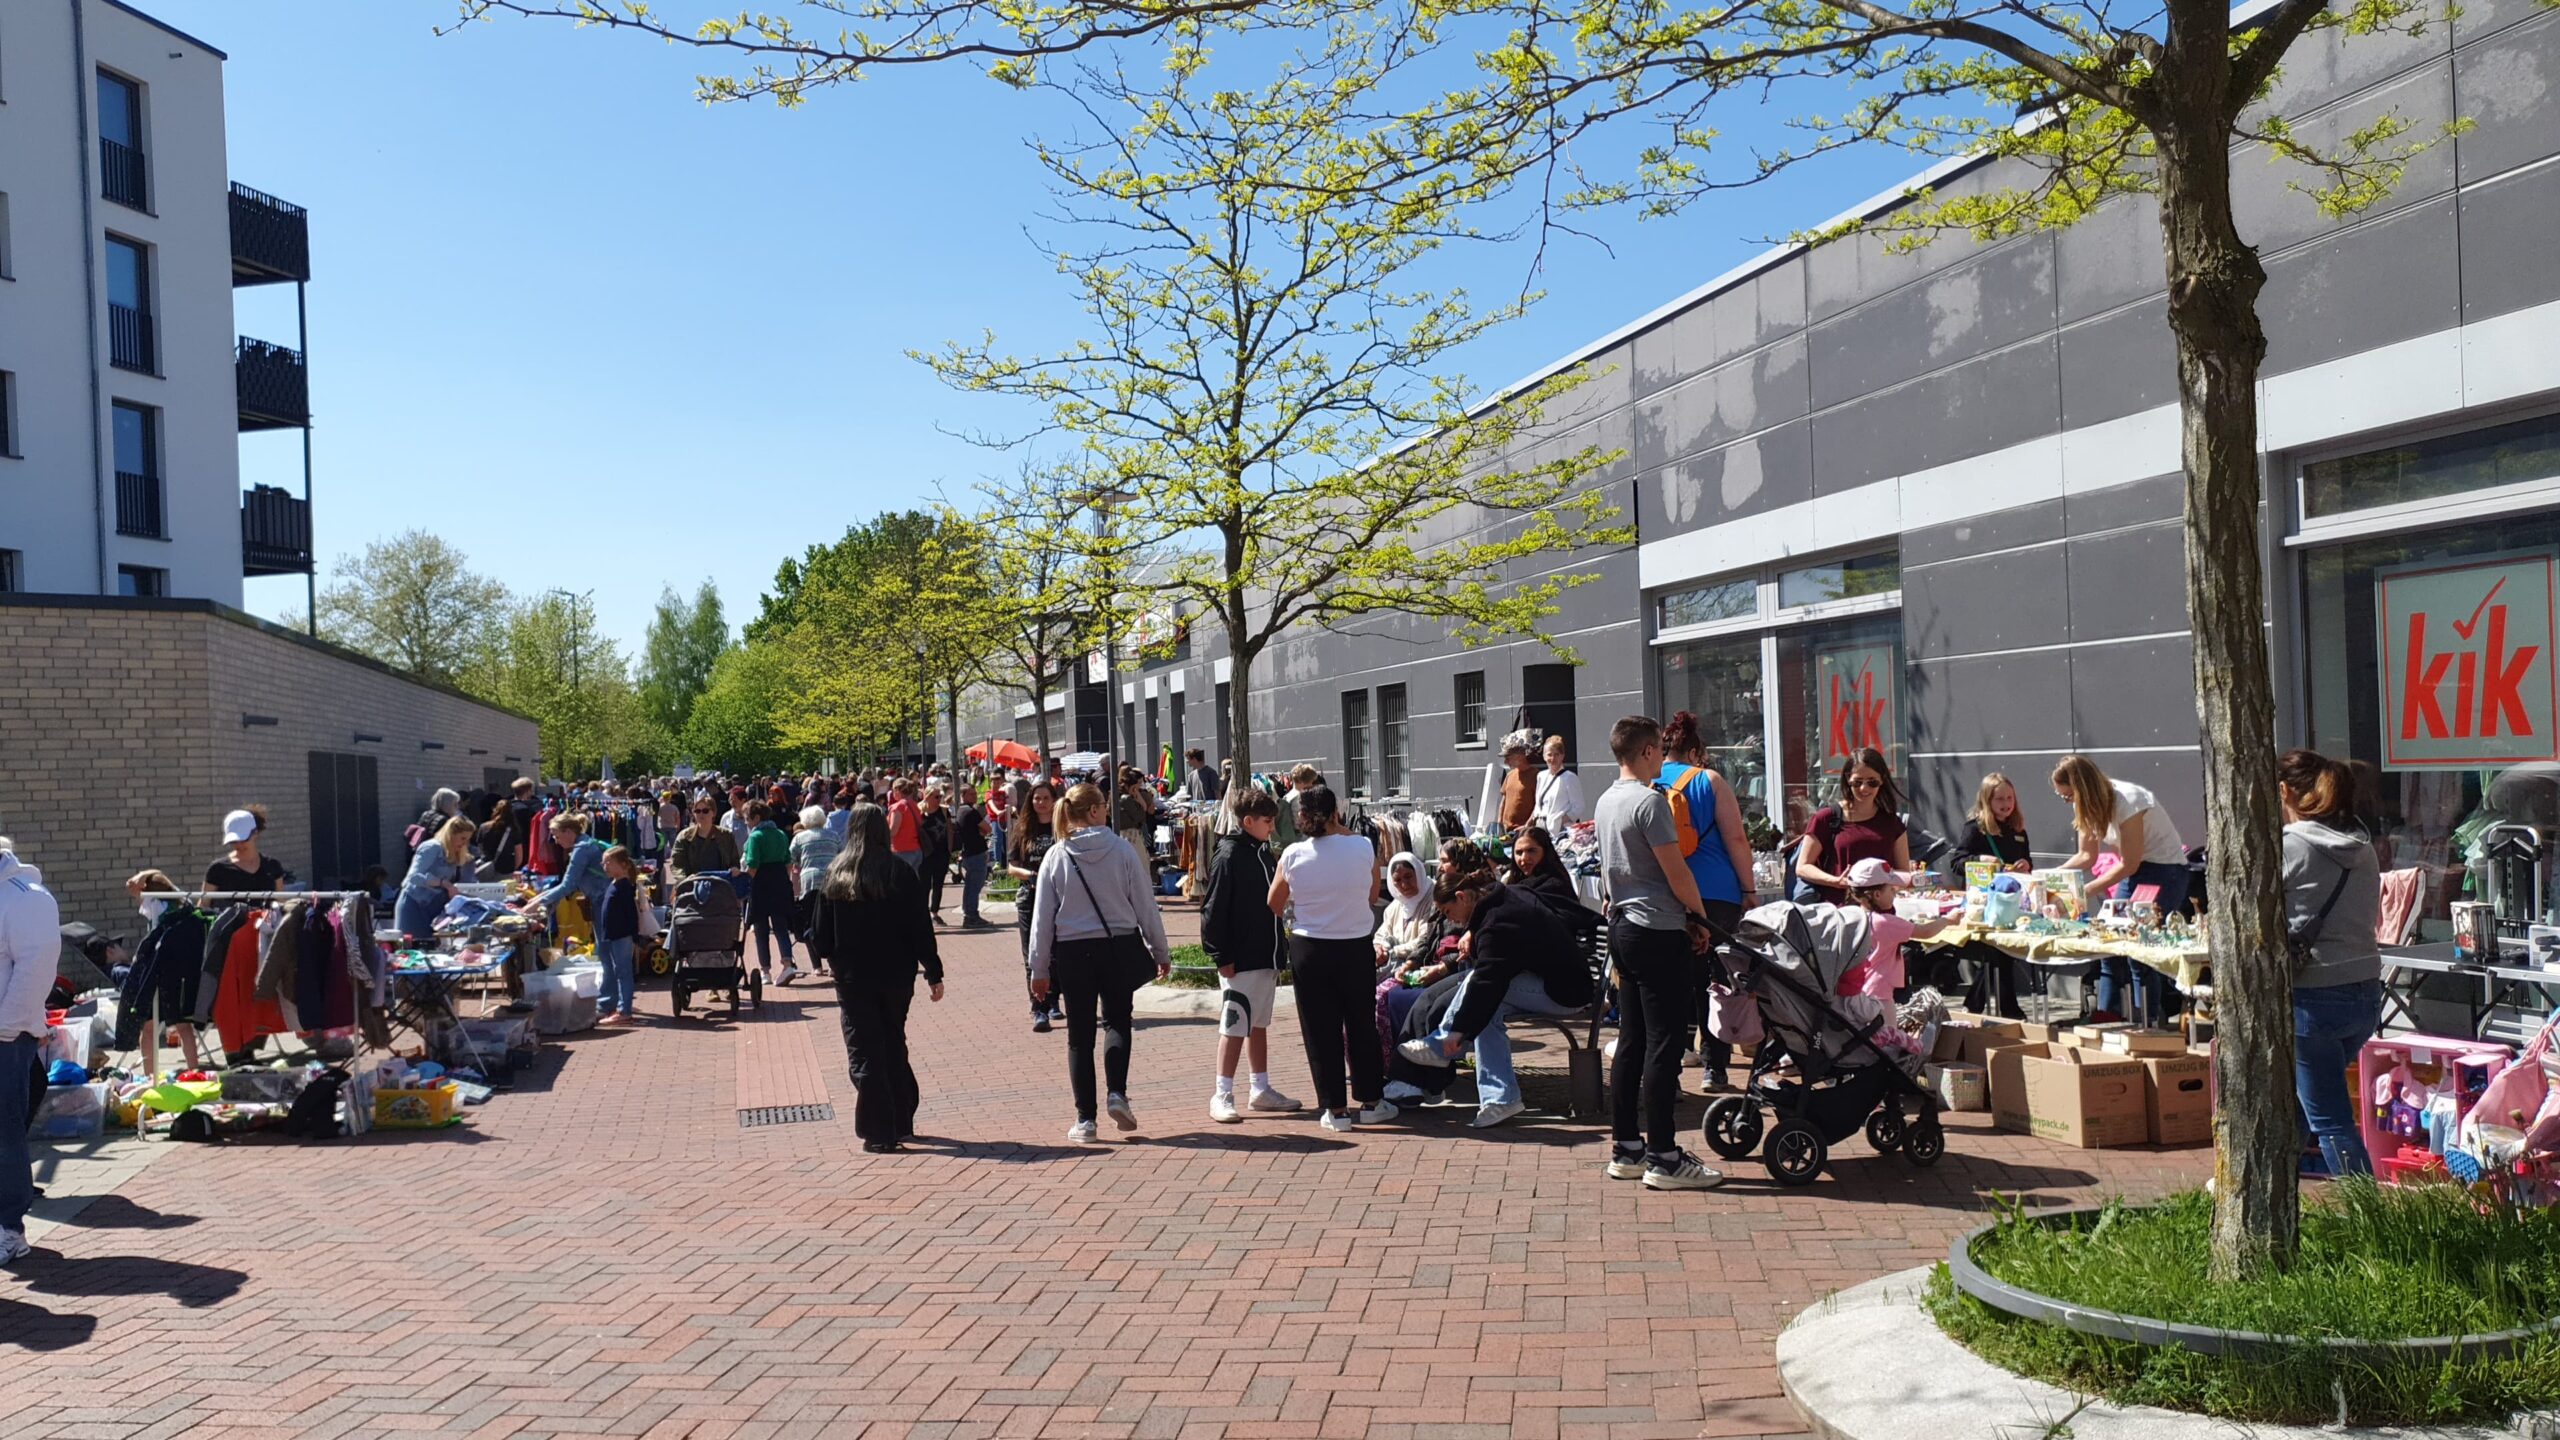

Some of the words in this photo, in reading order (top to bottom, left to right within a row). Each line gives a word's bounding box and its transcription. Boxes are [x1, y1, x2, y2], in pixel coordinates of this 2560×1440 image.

[2401, 575, 2540, 740] kik
[1829, 655, 1886, 758] kik
[2083, 1065, 2121, 1079] UMZUG
[2122, 1064, 2142, 1076] BOX
[2162, 1061, 2197, 1074] UMZUG
[2197, 1060, 2210, 1072] BO
